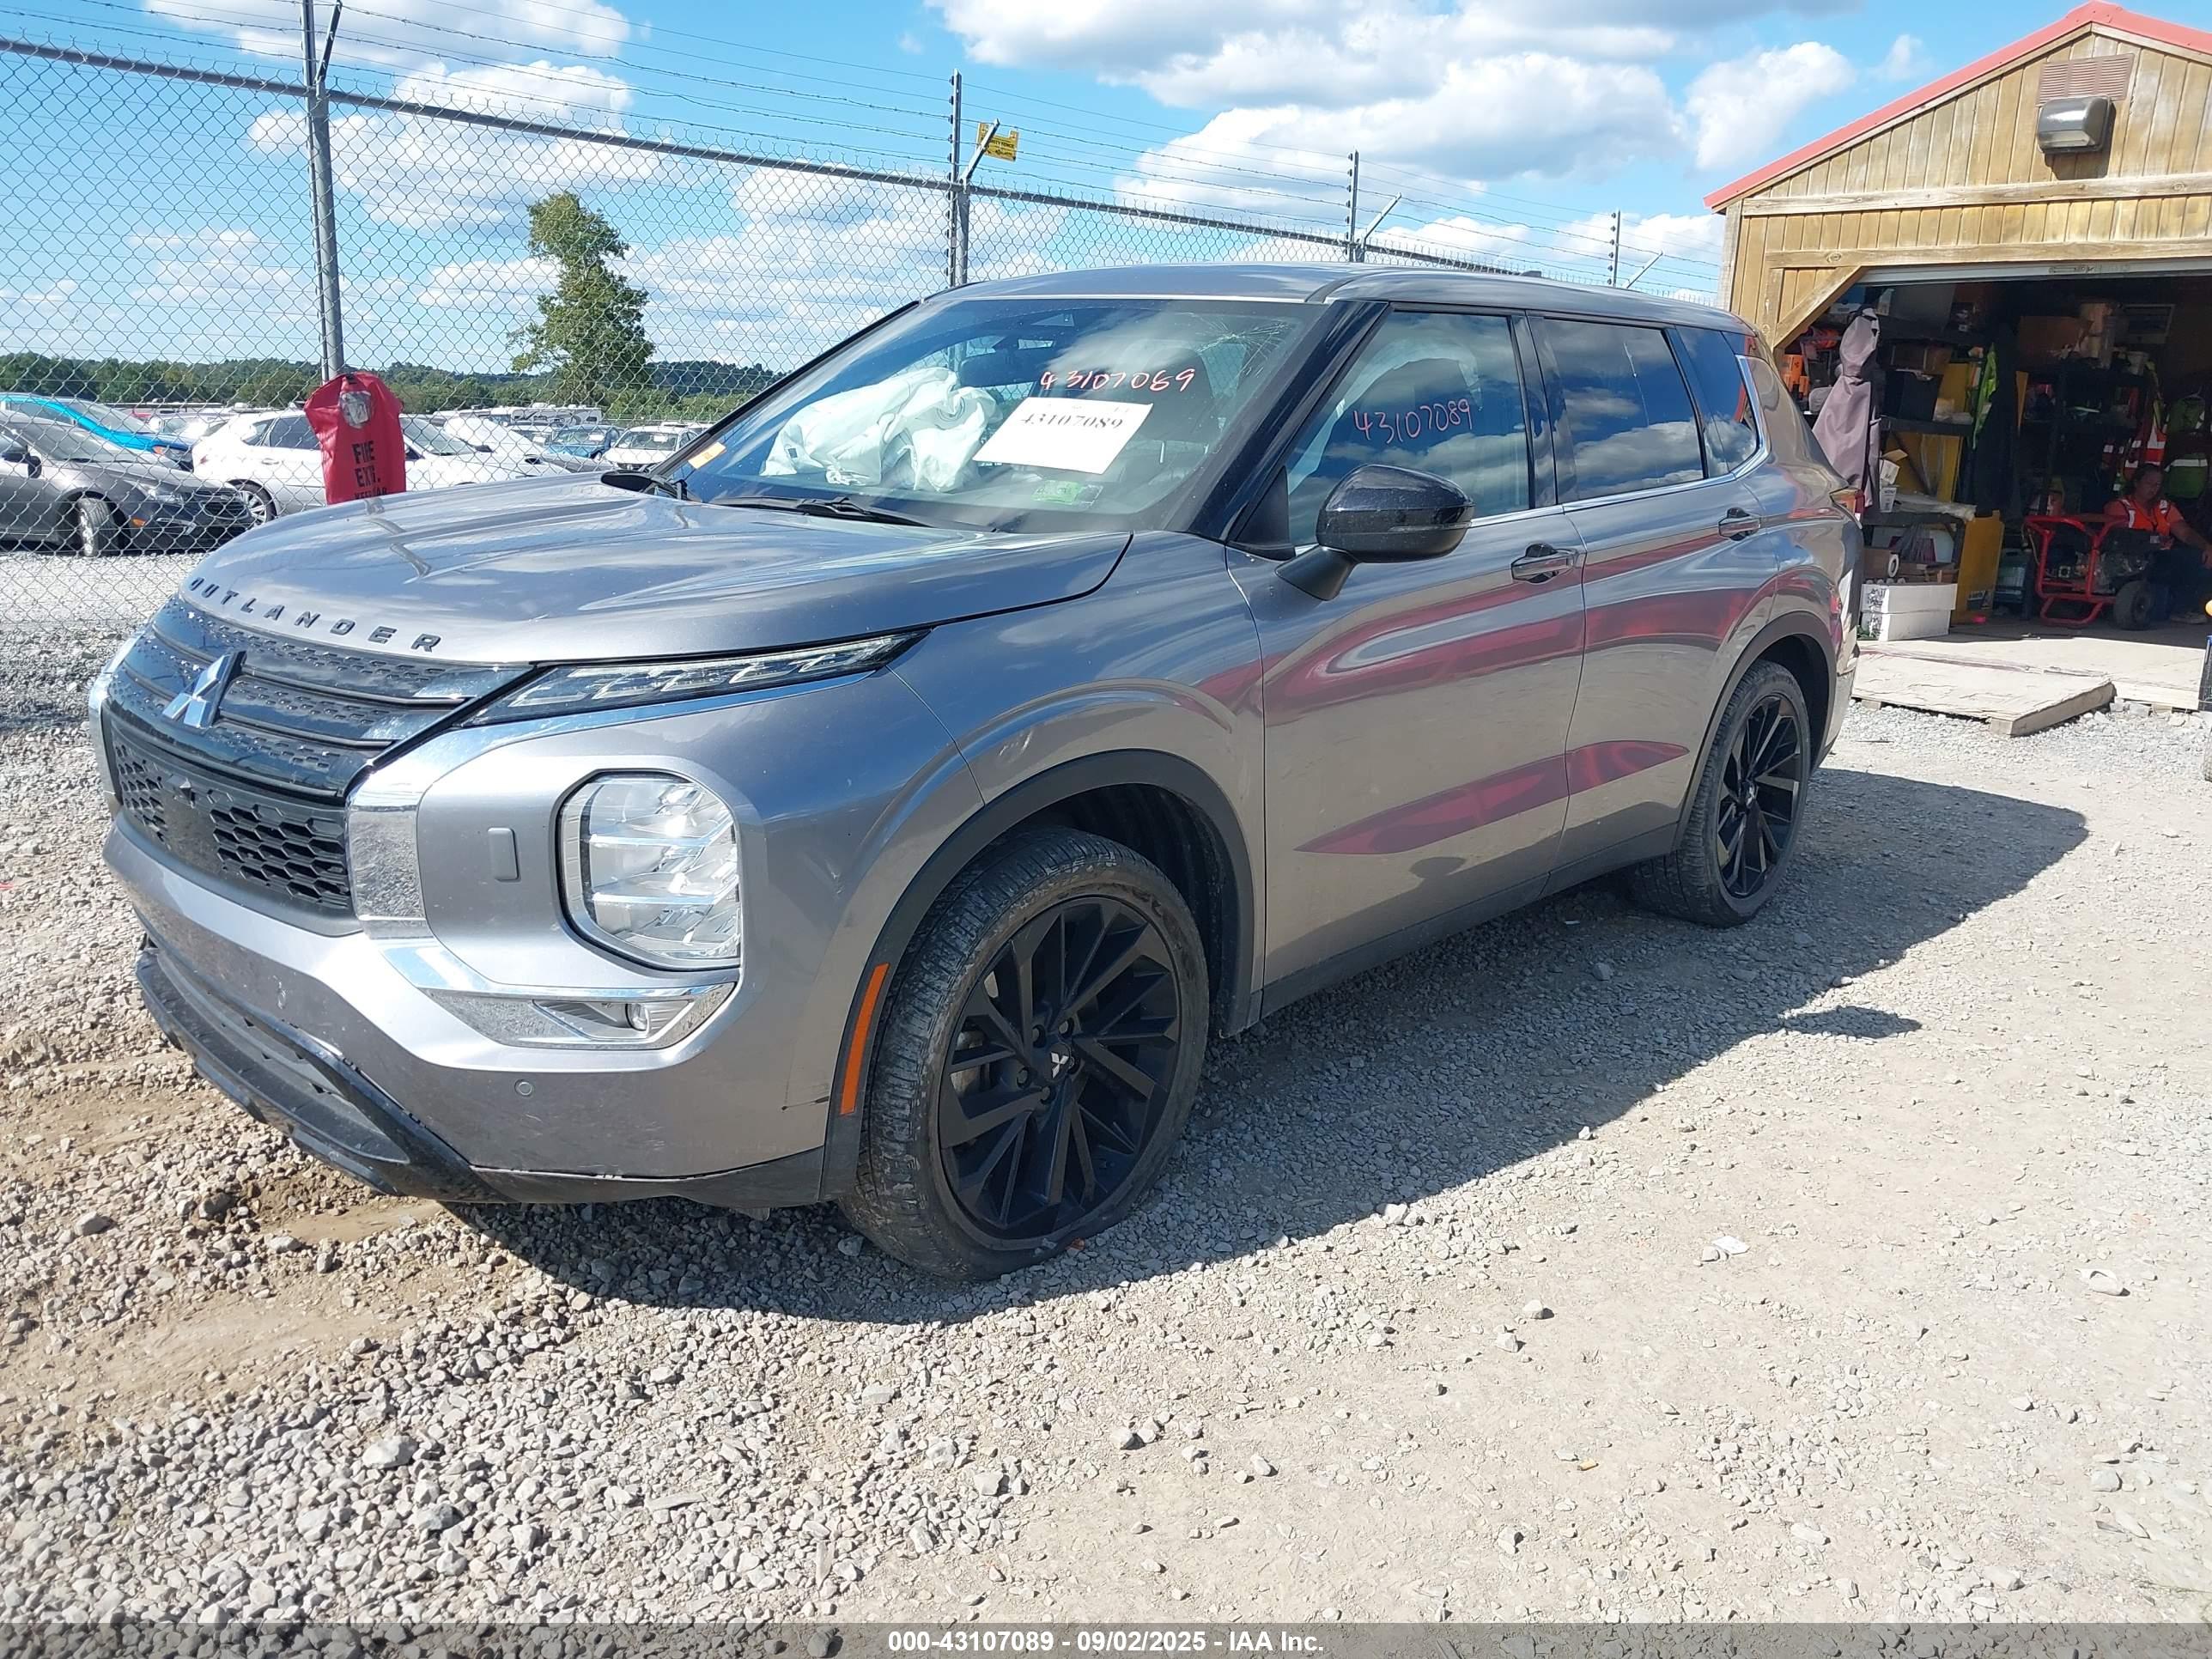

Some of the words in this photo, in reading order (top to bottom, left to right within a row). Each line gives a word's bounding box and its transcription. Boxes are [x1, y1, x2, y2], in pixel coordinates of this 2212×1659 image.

[1020, 412, 1123, 428] 43107089
[1353, 398, 1473, 445] 43107089
[188, 577, 442, 653] OUTLANDER
